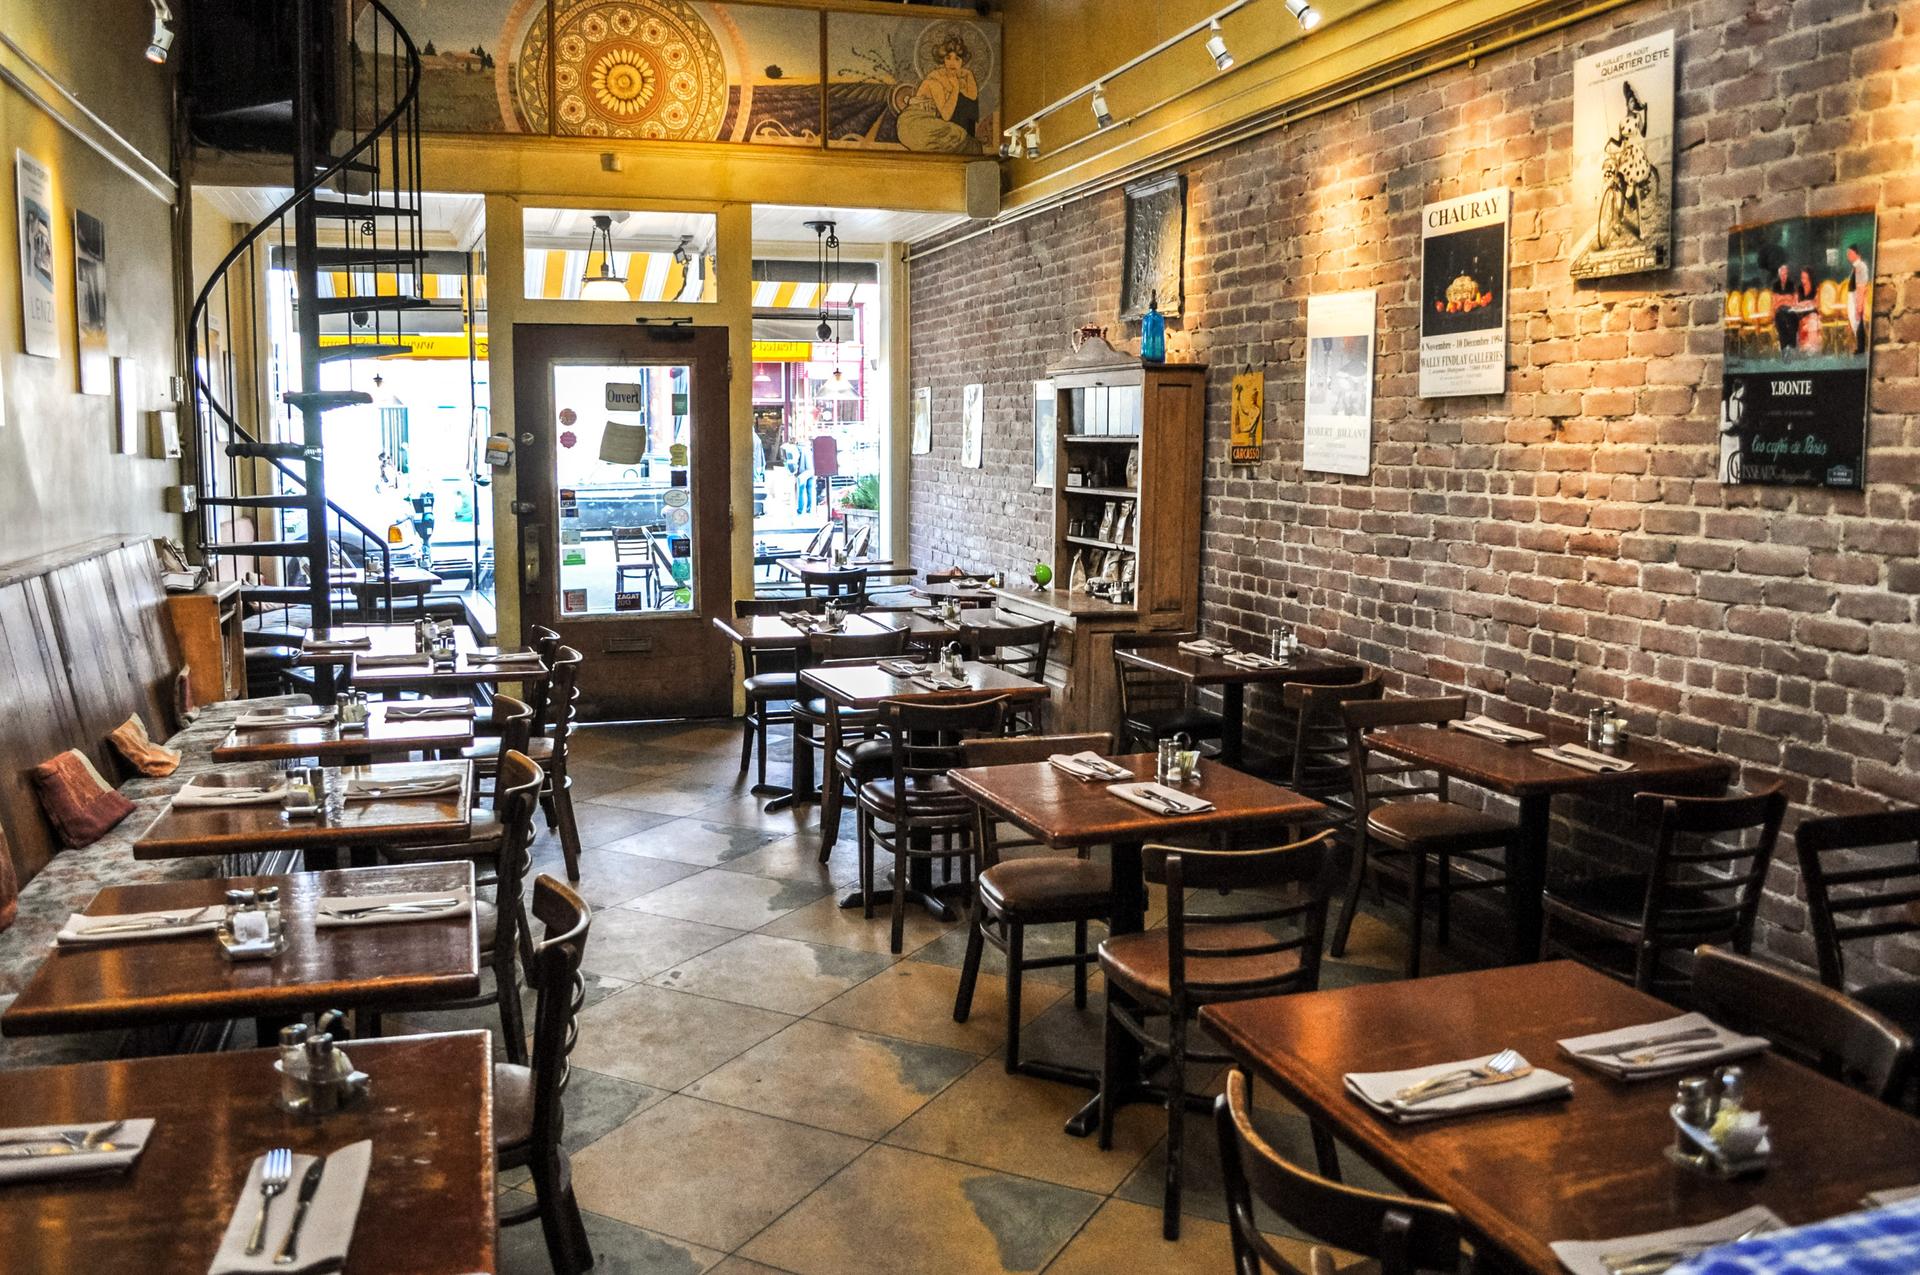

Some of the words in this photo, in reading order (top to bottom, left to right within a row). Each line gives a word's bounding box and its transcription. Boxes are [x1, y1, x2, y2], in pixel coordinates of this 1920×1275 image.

[1601, 56, 1643, 77] QUARTIER
[1428, 197, 1500, 228] CHAURAY
[1421, 356, 1441, 369] WALLY
[1469, 350, 1504, 365] GALLERIES
[607, 389, 639, 404] Ouvert
[1802, 434, 1828, 456] Paris
